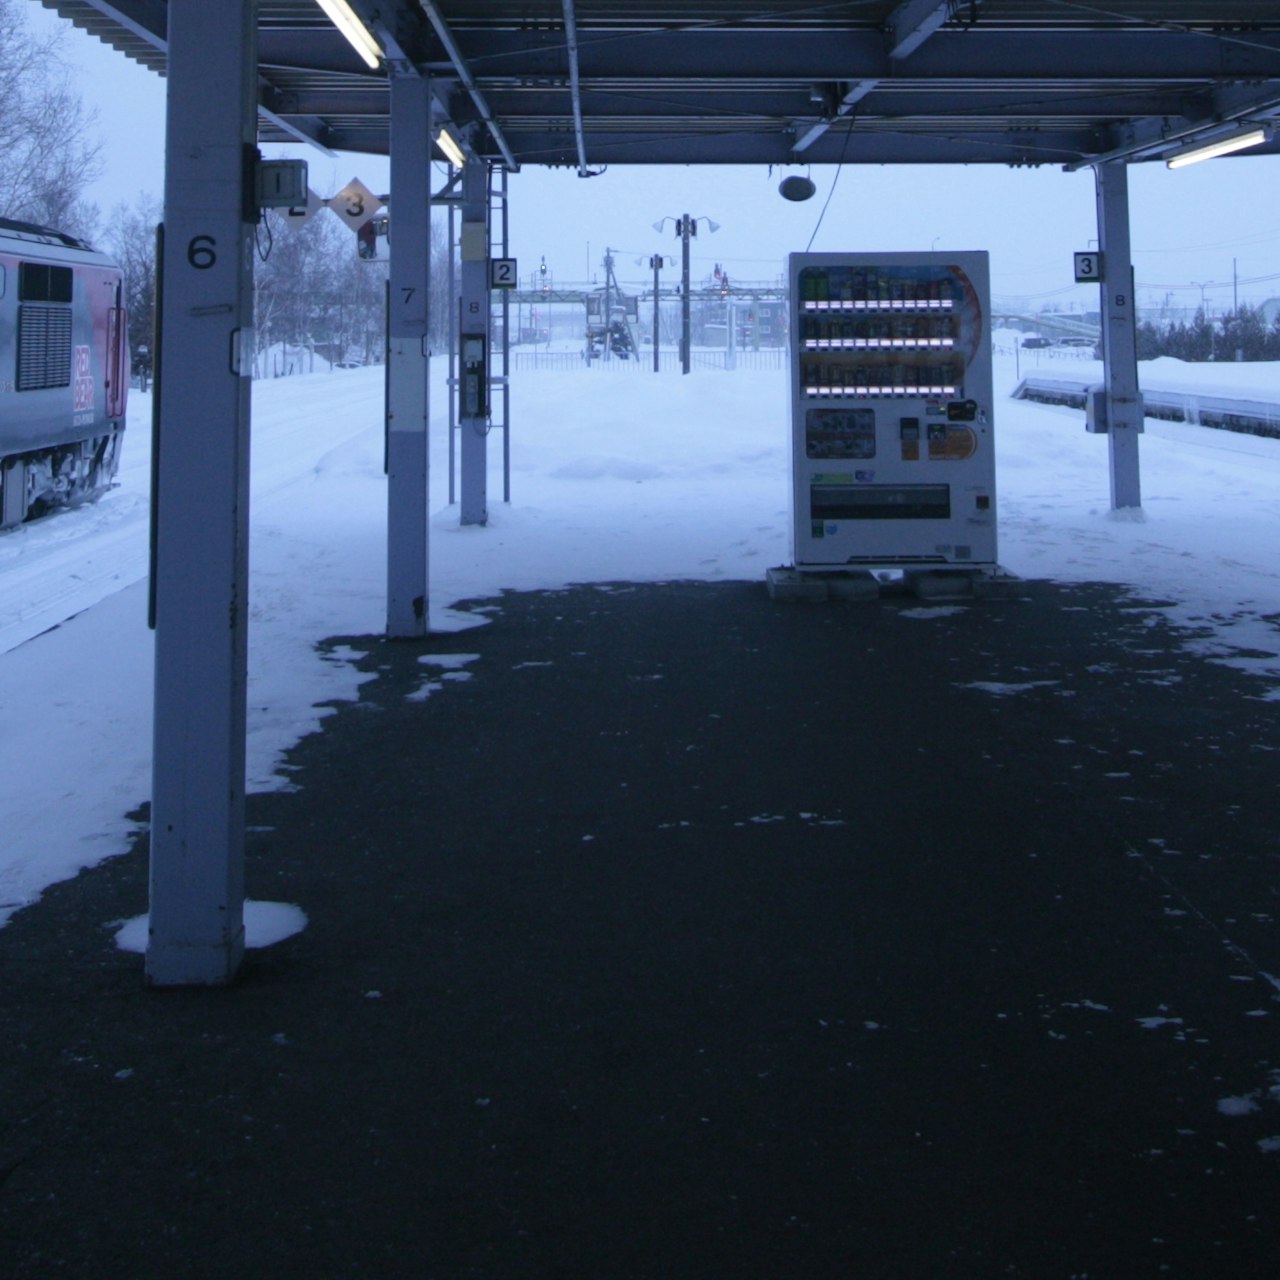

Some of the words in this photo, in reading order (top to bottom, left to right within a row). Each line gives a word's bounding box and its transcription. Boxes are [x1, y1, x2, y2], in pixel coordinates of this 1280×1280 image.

[345, 191, 365, 218] 3
[187, 235, 217, 270] 6
[498, 264, 511, 281] 2
[1081, 258, 1093, 274] 3
[400, 287, 416, 305] 7
[1115, 293, 1126, 307] 8
[468, 301, 480, 314] 8
